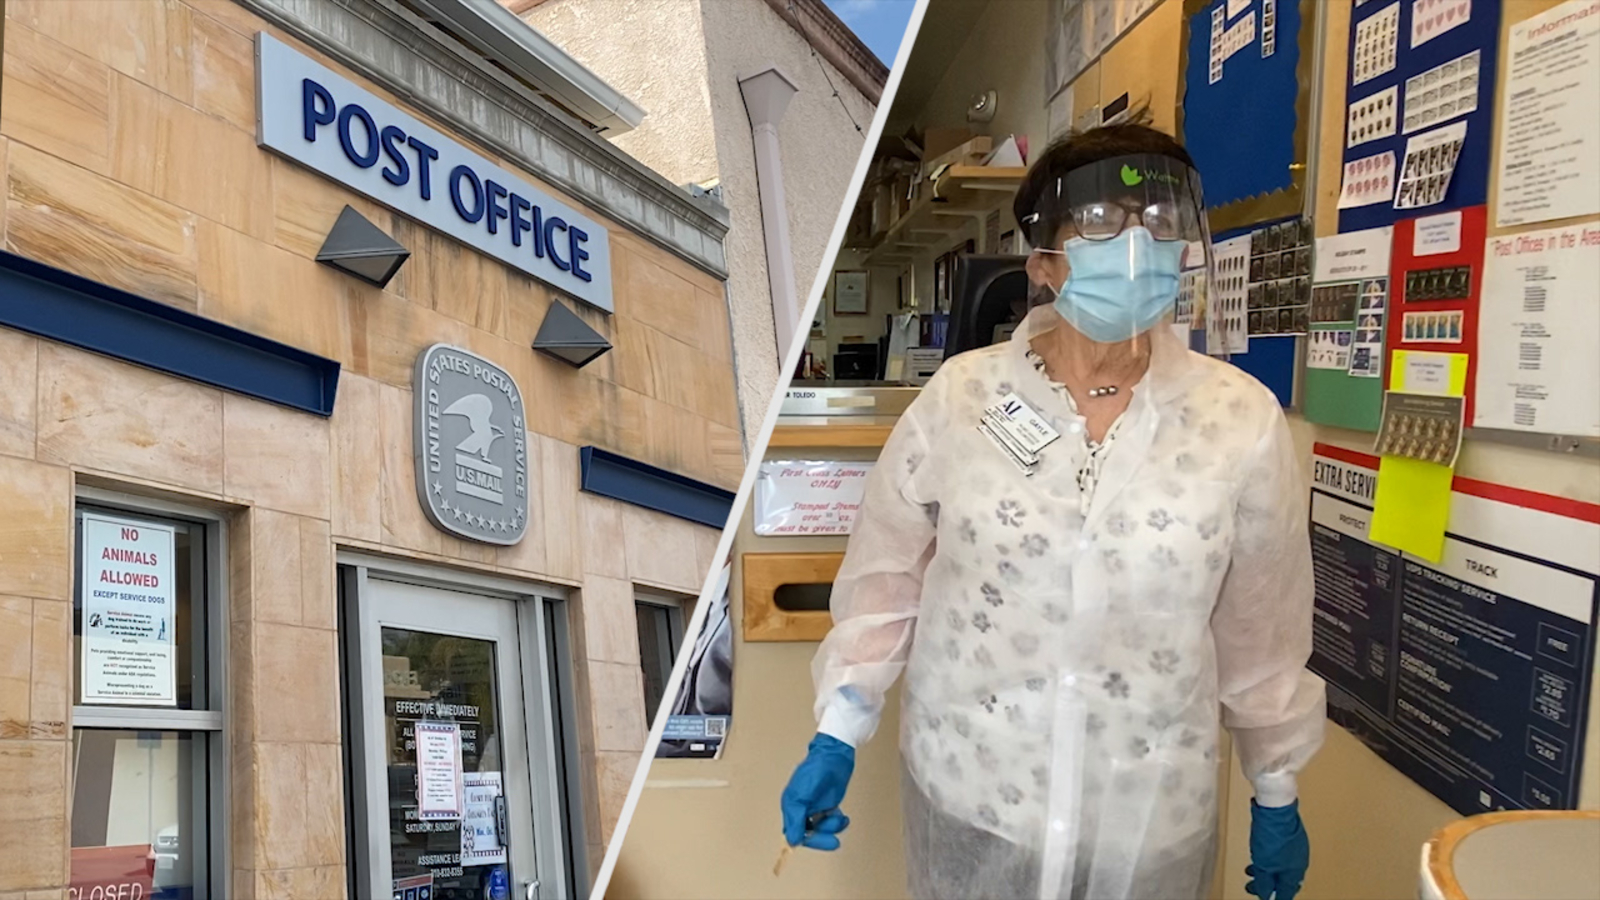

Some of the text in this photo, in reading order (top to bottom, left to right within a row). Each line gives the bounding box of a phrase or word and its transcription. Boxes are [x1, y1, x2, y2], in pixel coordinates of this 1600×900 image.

[303, 78, 592, 283] POST OFFICE
[1561, 231, 1575, 249] the
[428, 354, 525, 499] UNITED STATES POSTAL SERVICE
[780, 468, 803, 477] First
[1314, 460, 1376, 501] EXTRA SERVI
[810, 479, 841, 490] ONLY
[791, 502, 830, 511] Stamped
[812, 525, 836, 533] given
[1339, 513, 1366, 531] PROTECT
[121, 527, 139, 541] NO
[102, 547, 157, 566] ANIMALS
[1465, 559, 1498, 579] TRACK
[100, 569, 158, 588] ALLOWED
[93, 590, 165, 604] EXCEPT SERVICE DOGS
[1461, 583, 1498, 605] SERVICE
[396, 701, 435, 715] EFFECTIVE
[403, 727, 476, 739] ALL RVICE
[417, 854, 451, 866] ASSISTANCE
